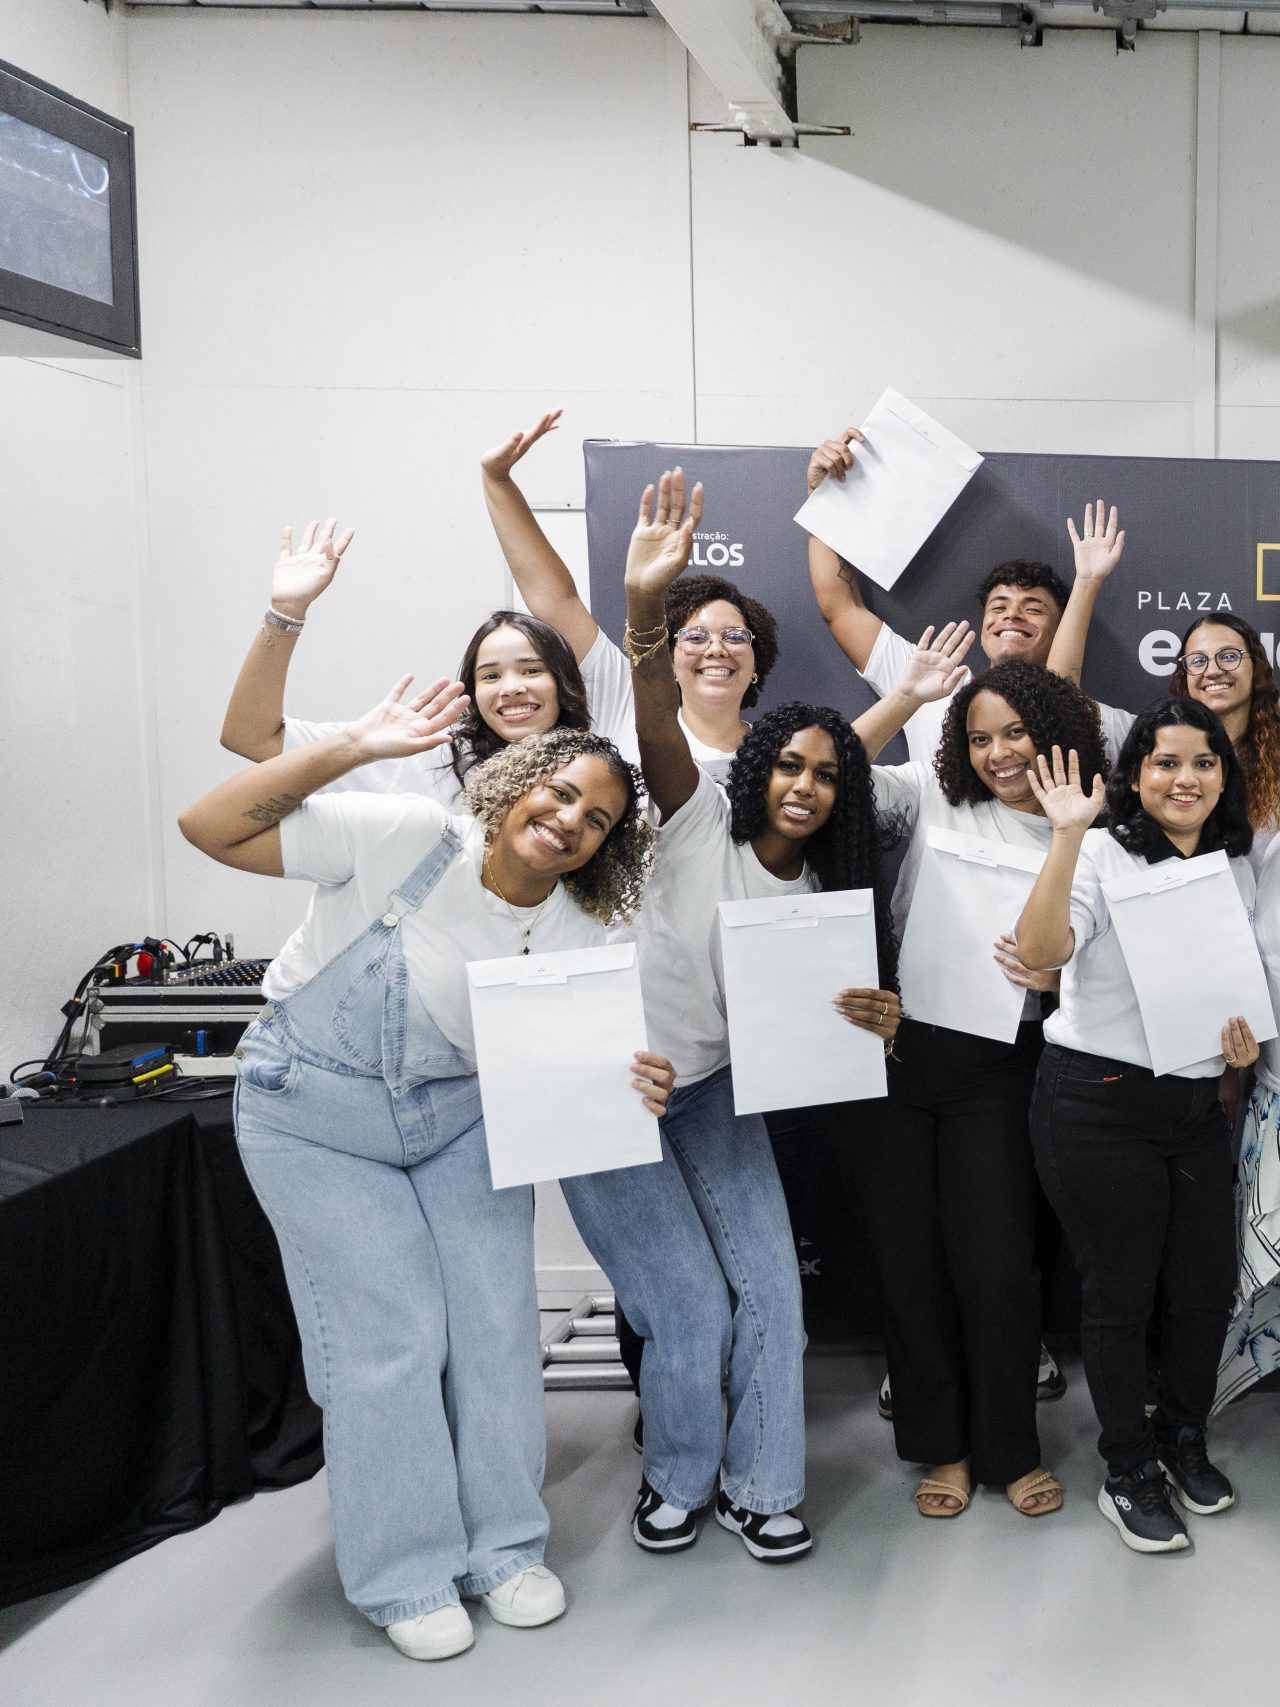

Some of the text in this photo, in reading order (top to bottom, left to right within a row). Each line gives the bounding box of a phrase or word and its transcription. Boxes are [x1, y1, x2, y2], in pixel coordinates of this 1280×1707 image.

[692, 531, 729, 541] stração:
[688, 542, 745, 567] LOS
[1138, 591, 1232, 611] PLAZA
